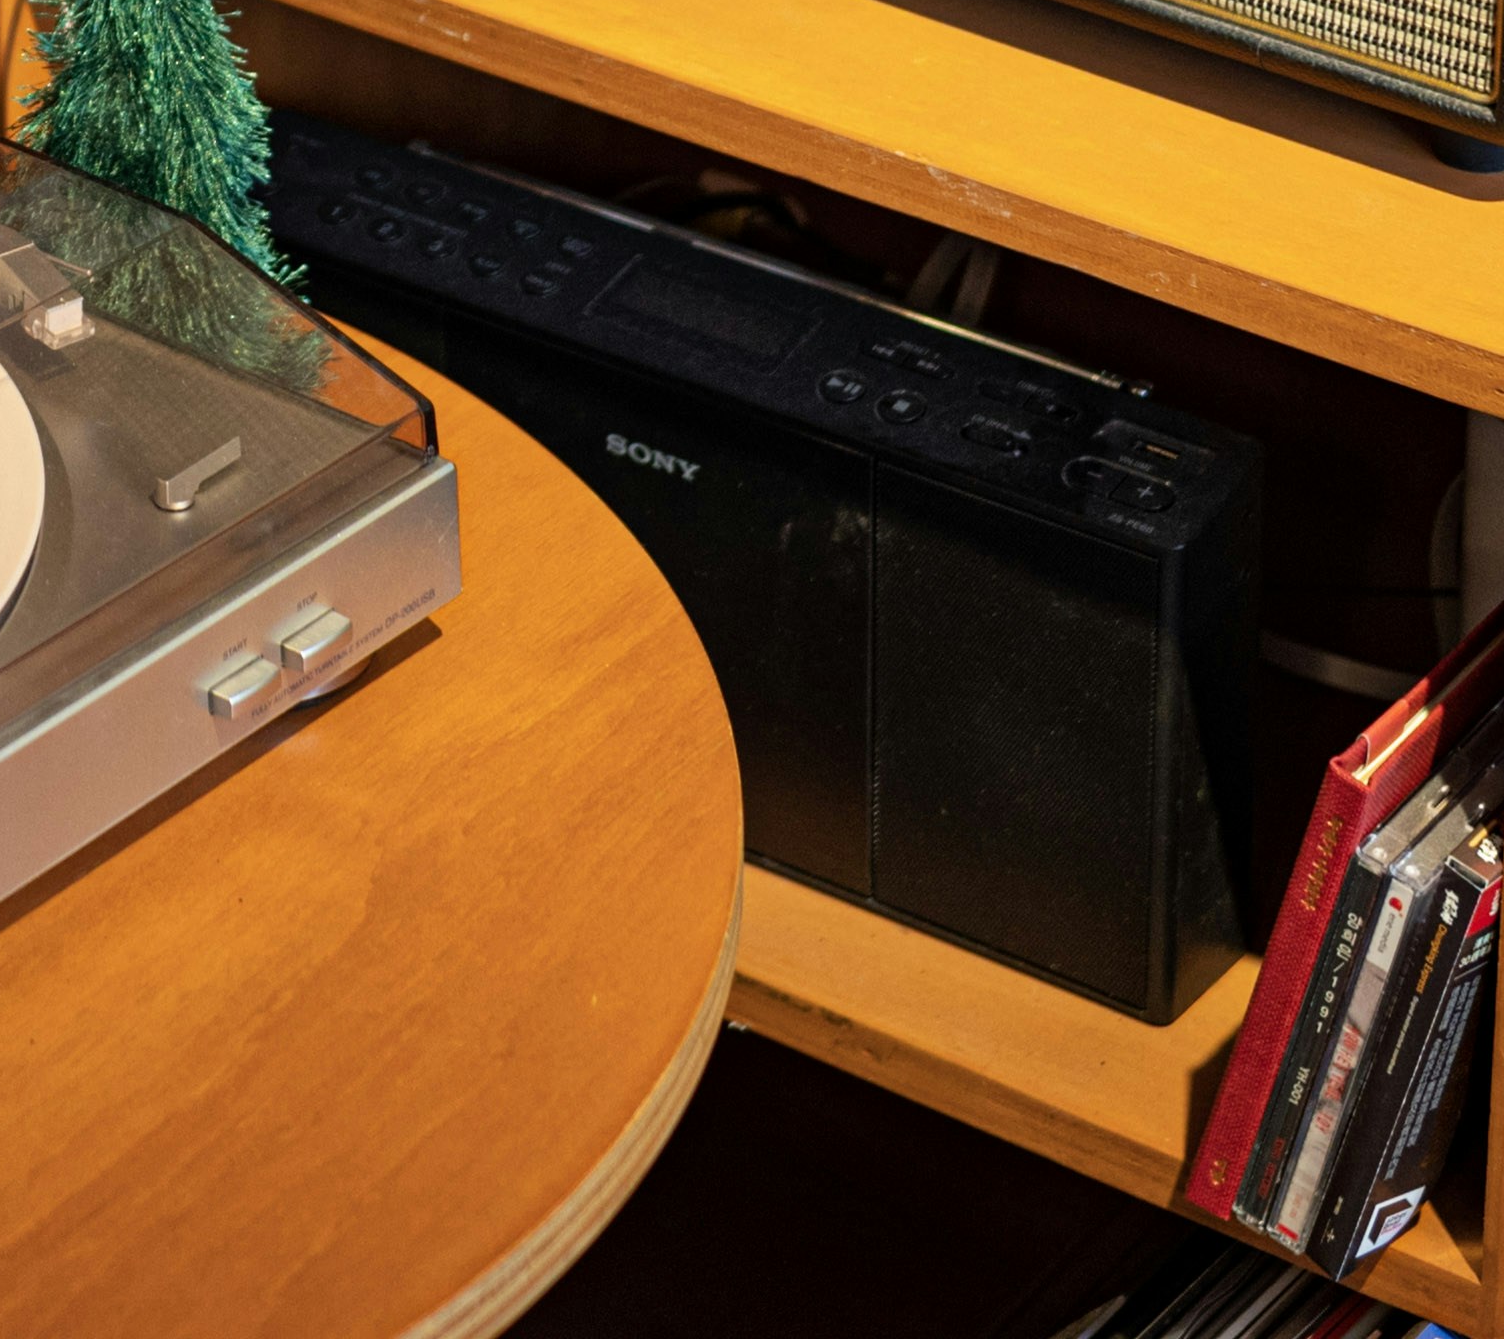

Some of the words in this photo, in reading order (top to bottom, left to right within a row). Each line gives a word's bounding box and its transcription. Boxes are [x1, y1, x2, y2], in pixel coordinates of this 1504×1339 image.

[606, 433, 701, 482] SONY
[296, 591, 318, 612] STOP
[222, 638, 249, 661] START
[251, 699, 275, 718] FULLY
[274, 673, 314, 704] AUTOMATIC
[314, 645, 355, 682] TURNTABLE
[355, 626, 386, 649] SYSTEM
[1427, 925, 1449, 970] Chungking
[1416, 966, 1438, 997] Express
[1289, 1066, 1311, 1106] YH-001
